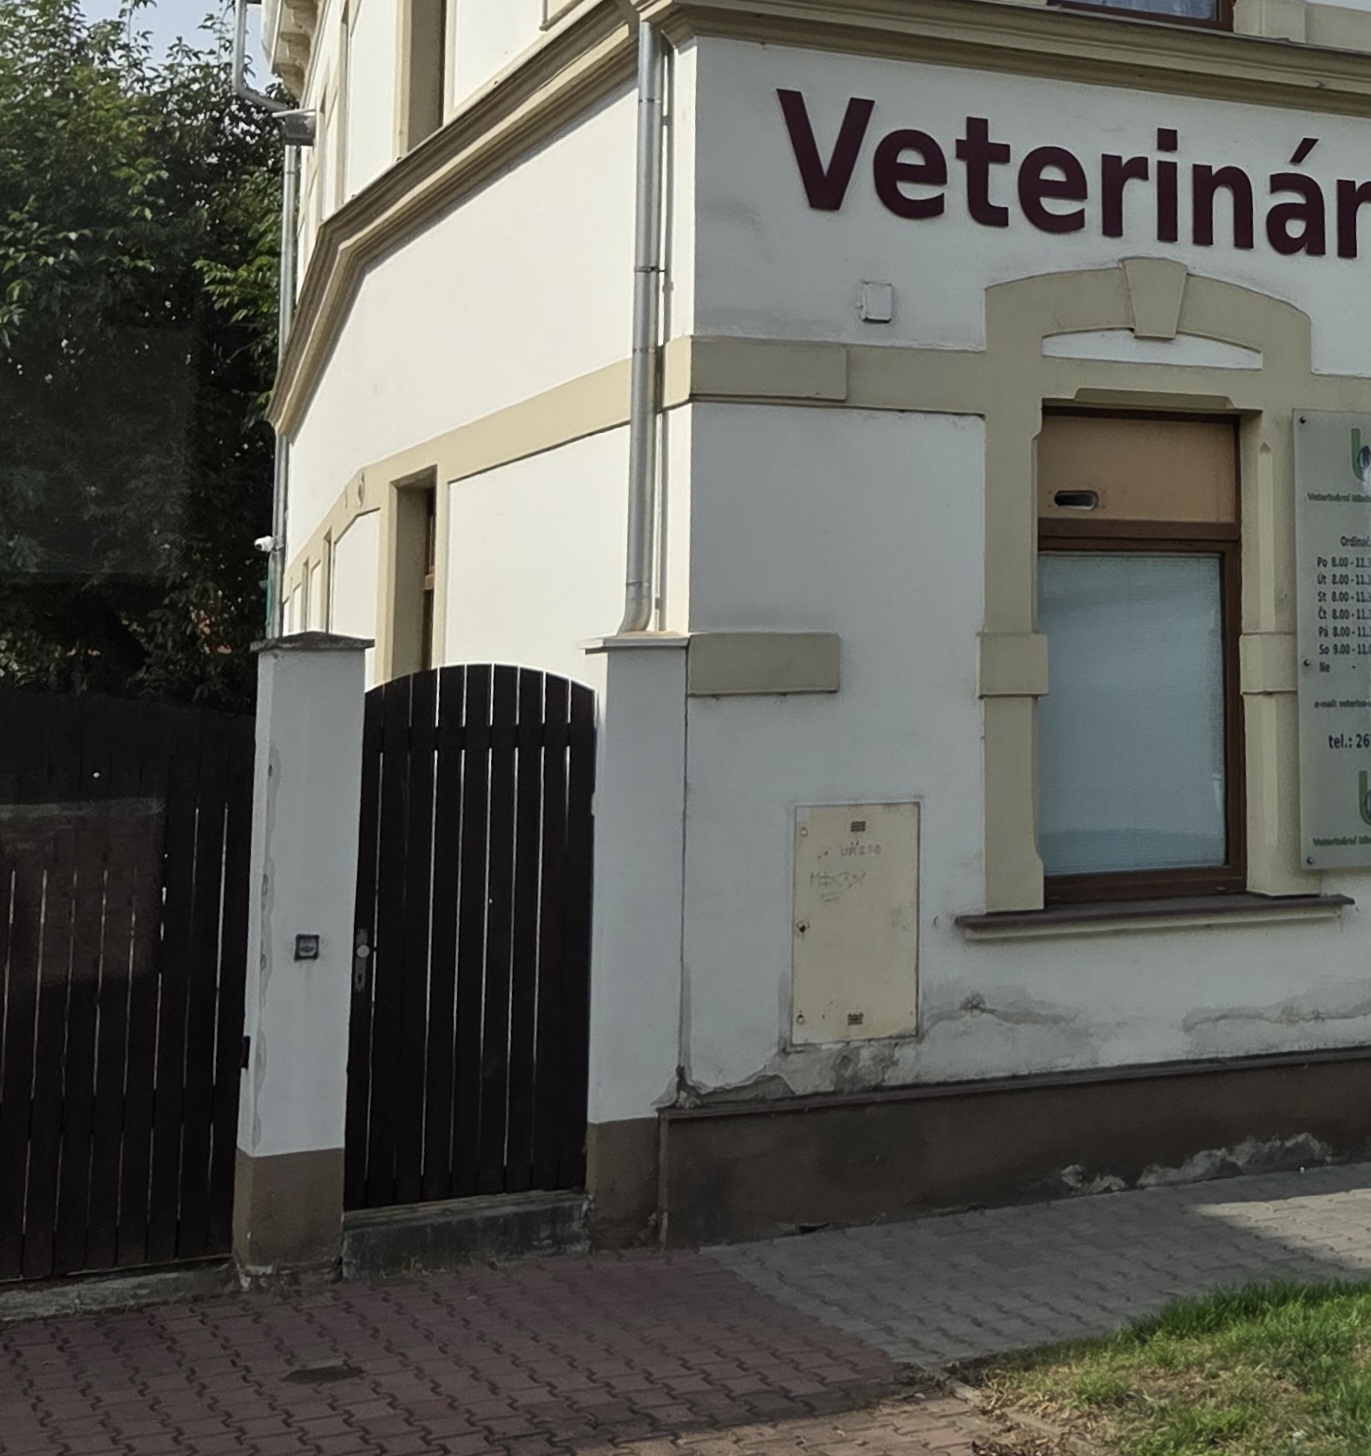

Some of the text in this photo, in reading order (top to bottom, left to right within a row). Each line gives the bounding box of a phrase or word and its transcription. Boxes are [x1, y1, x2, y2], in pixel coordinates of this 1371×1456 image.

[1318, 643, 1330, 655] So
[1319, 661, 1331, 673] Ne
[1328, 732, 1352, 749] tel.:
